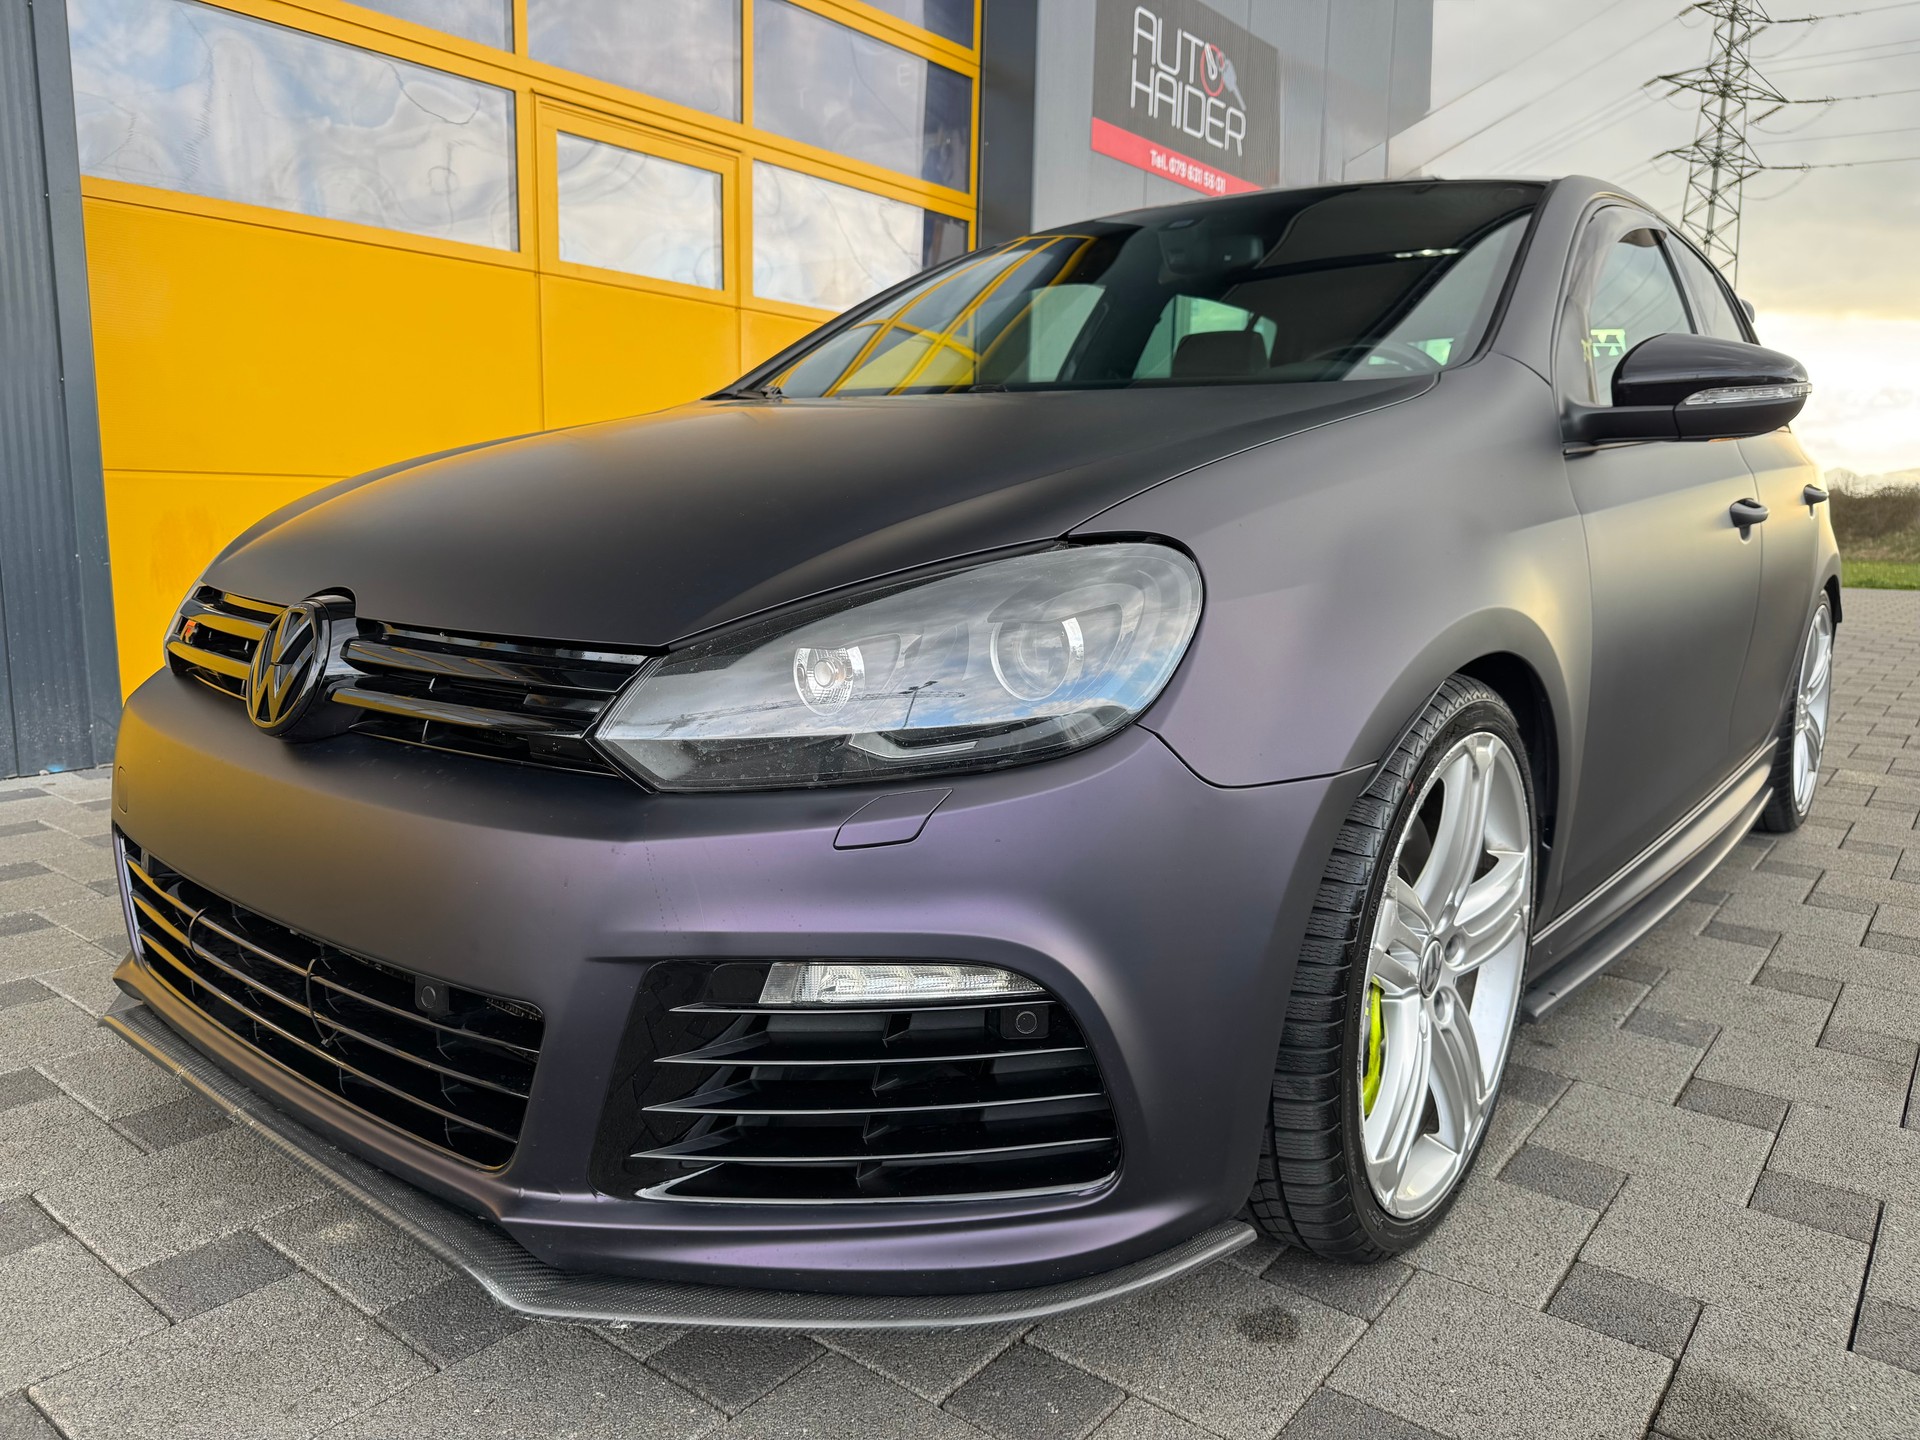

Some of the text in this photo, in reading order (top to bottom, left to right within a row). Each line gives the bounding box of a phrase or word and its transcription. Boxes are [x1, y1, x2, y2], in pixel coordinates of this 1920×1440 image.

[1130, 57, 1247, 157] HAIDER
[1150, 149, 1168, 171] Tel.
[1168, 156, 1187, 178] 079
